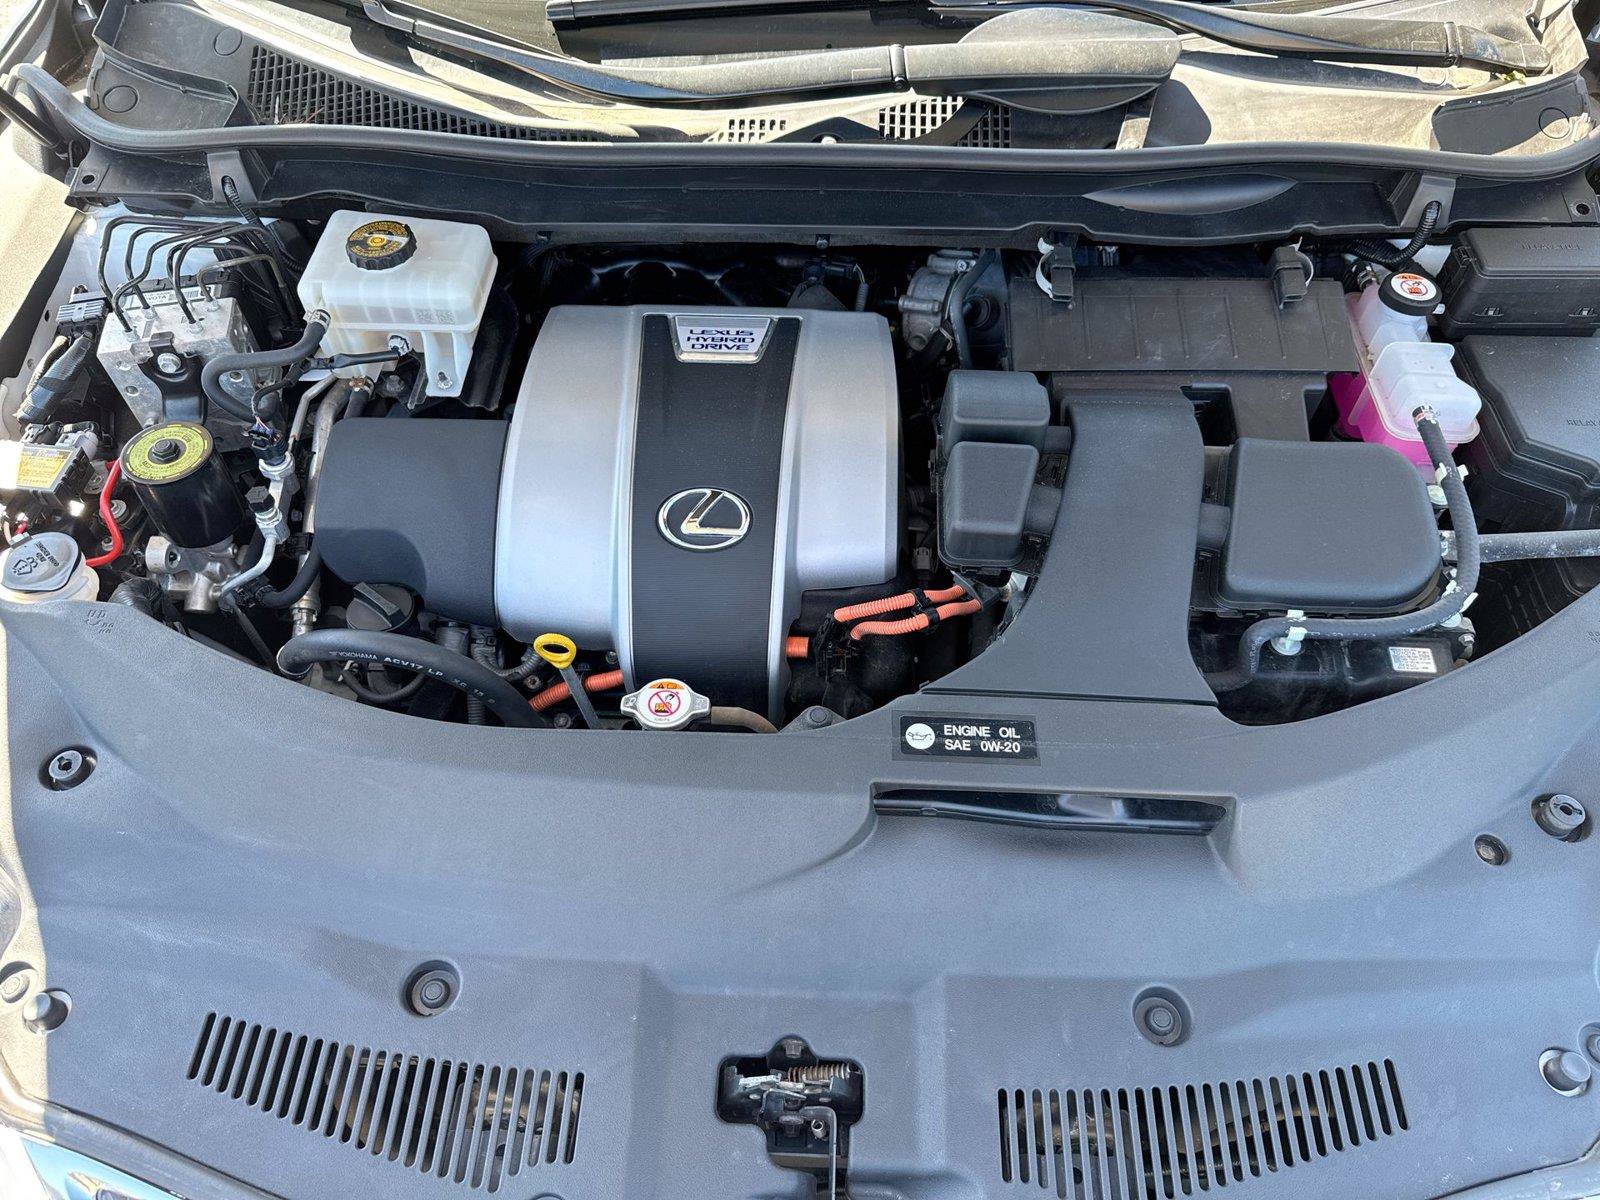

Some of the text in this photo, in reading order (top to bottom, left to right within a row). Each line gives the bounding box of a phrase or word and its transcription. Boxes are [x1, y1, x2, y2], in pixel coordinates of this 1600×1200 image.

[338, 652, 378, 661] YOKOHAMA
[383, 657, 424, 670] ACV17
[427, 668, 444, 677] LP
[943, 725, 1021, 739] ENGINE OIL
[944, 739, 1021, 753] SAE 0W-20
